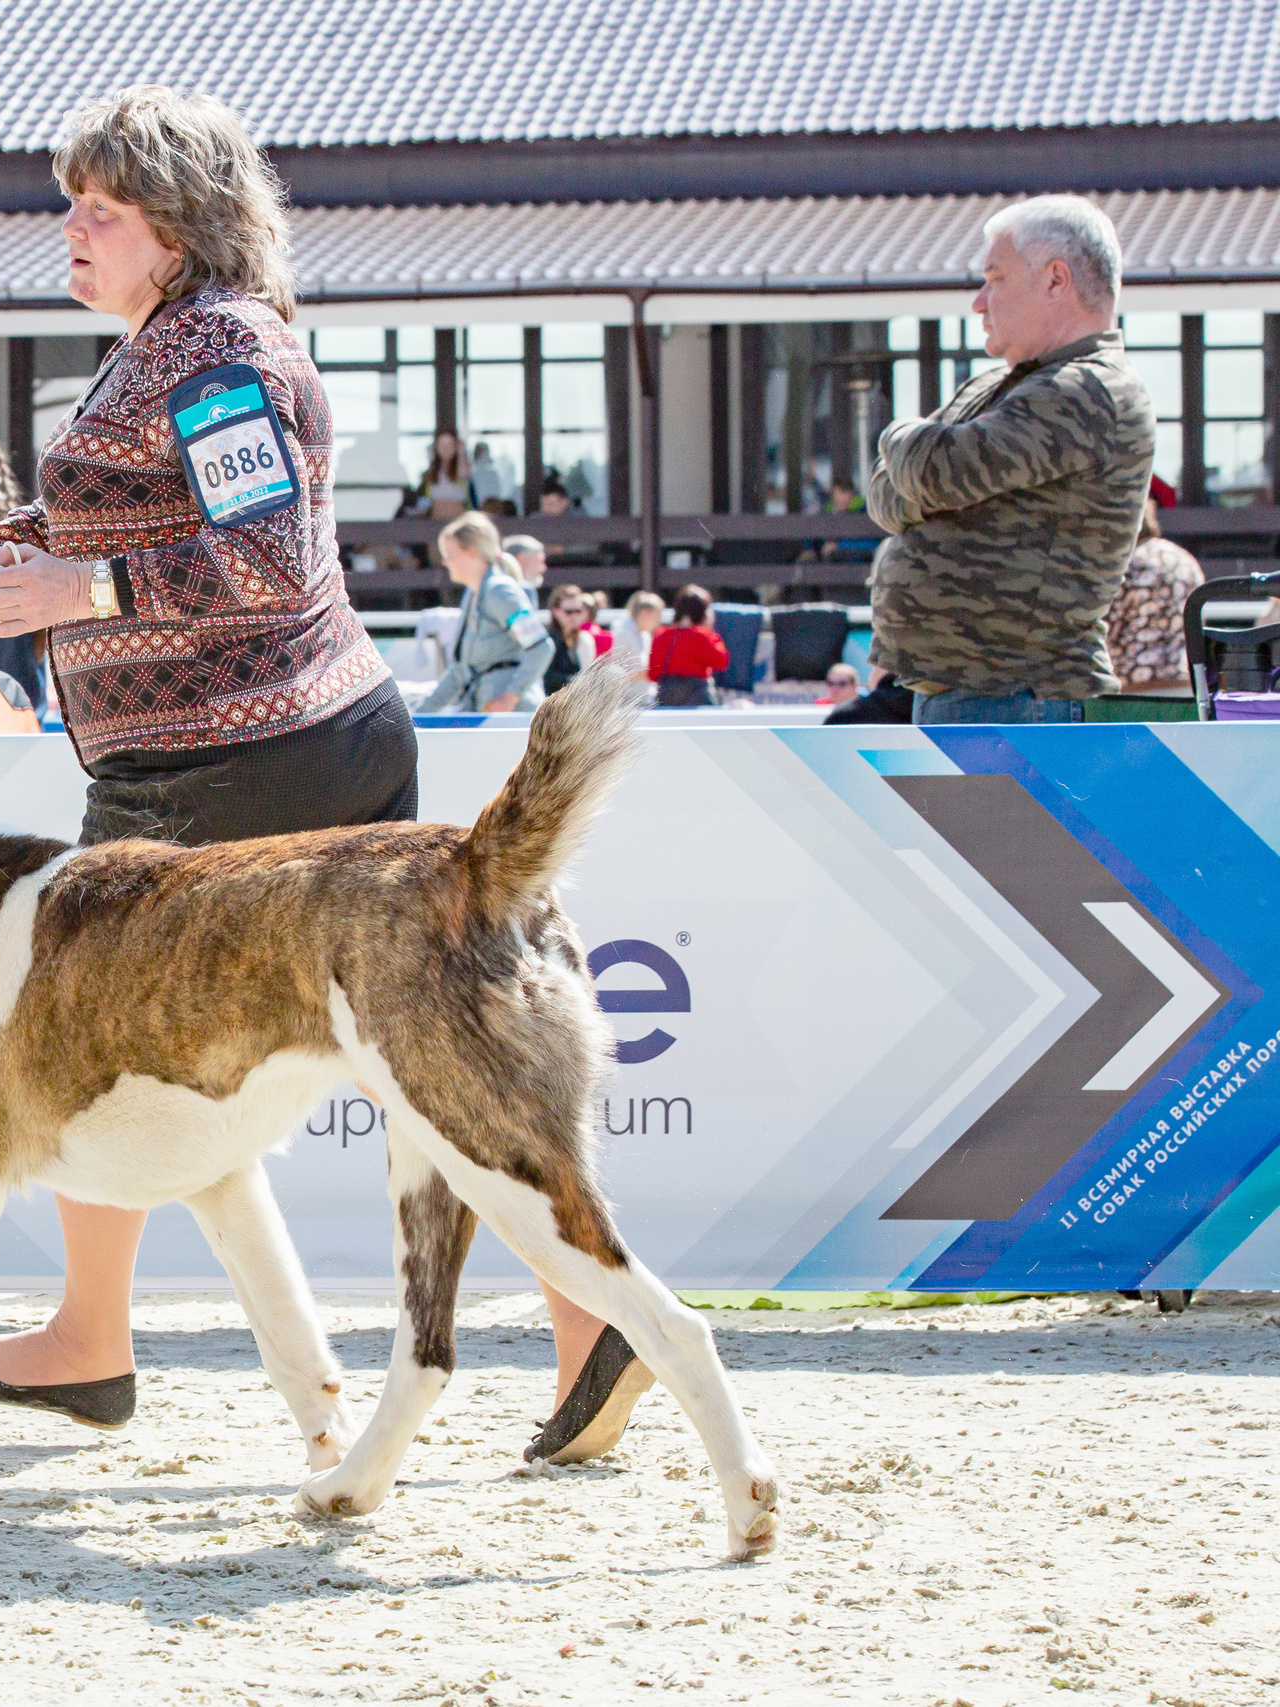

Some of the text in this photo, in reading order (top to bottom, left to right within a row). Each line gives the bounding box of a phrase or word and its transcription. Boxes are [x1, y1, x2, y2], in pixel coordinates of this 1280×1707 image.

[205, 442, 274, 489] 0886
[229, 486, 269, 507] 21.05.2022
[1059, 1041, 1252, 1230] II ВСЕМИРНАЯ ВЫСТАВКА
[1093, 1173, 1146, 1225] СОБАК
[1144, 1071, 1247, 1174] РОССИЙСКИХ
